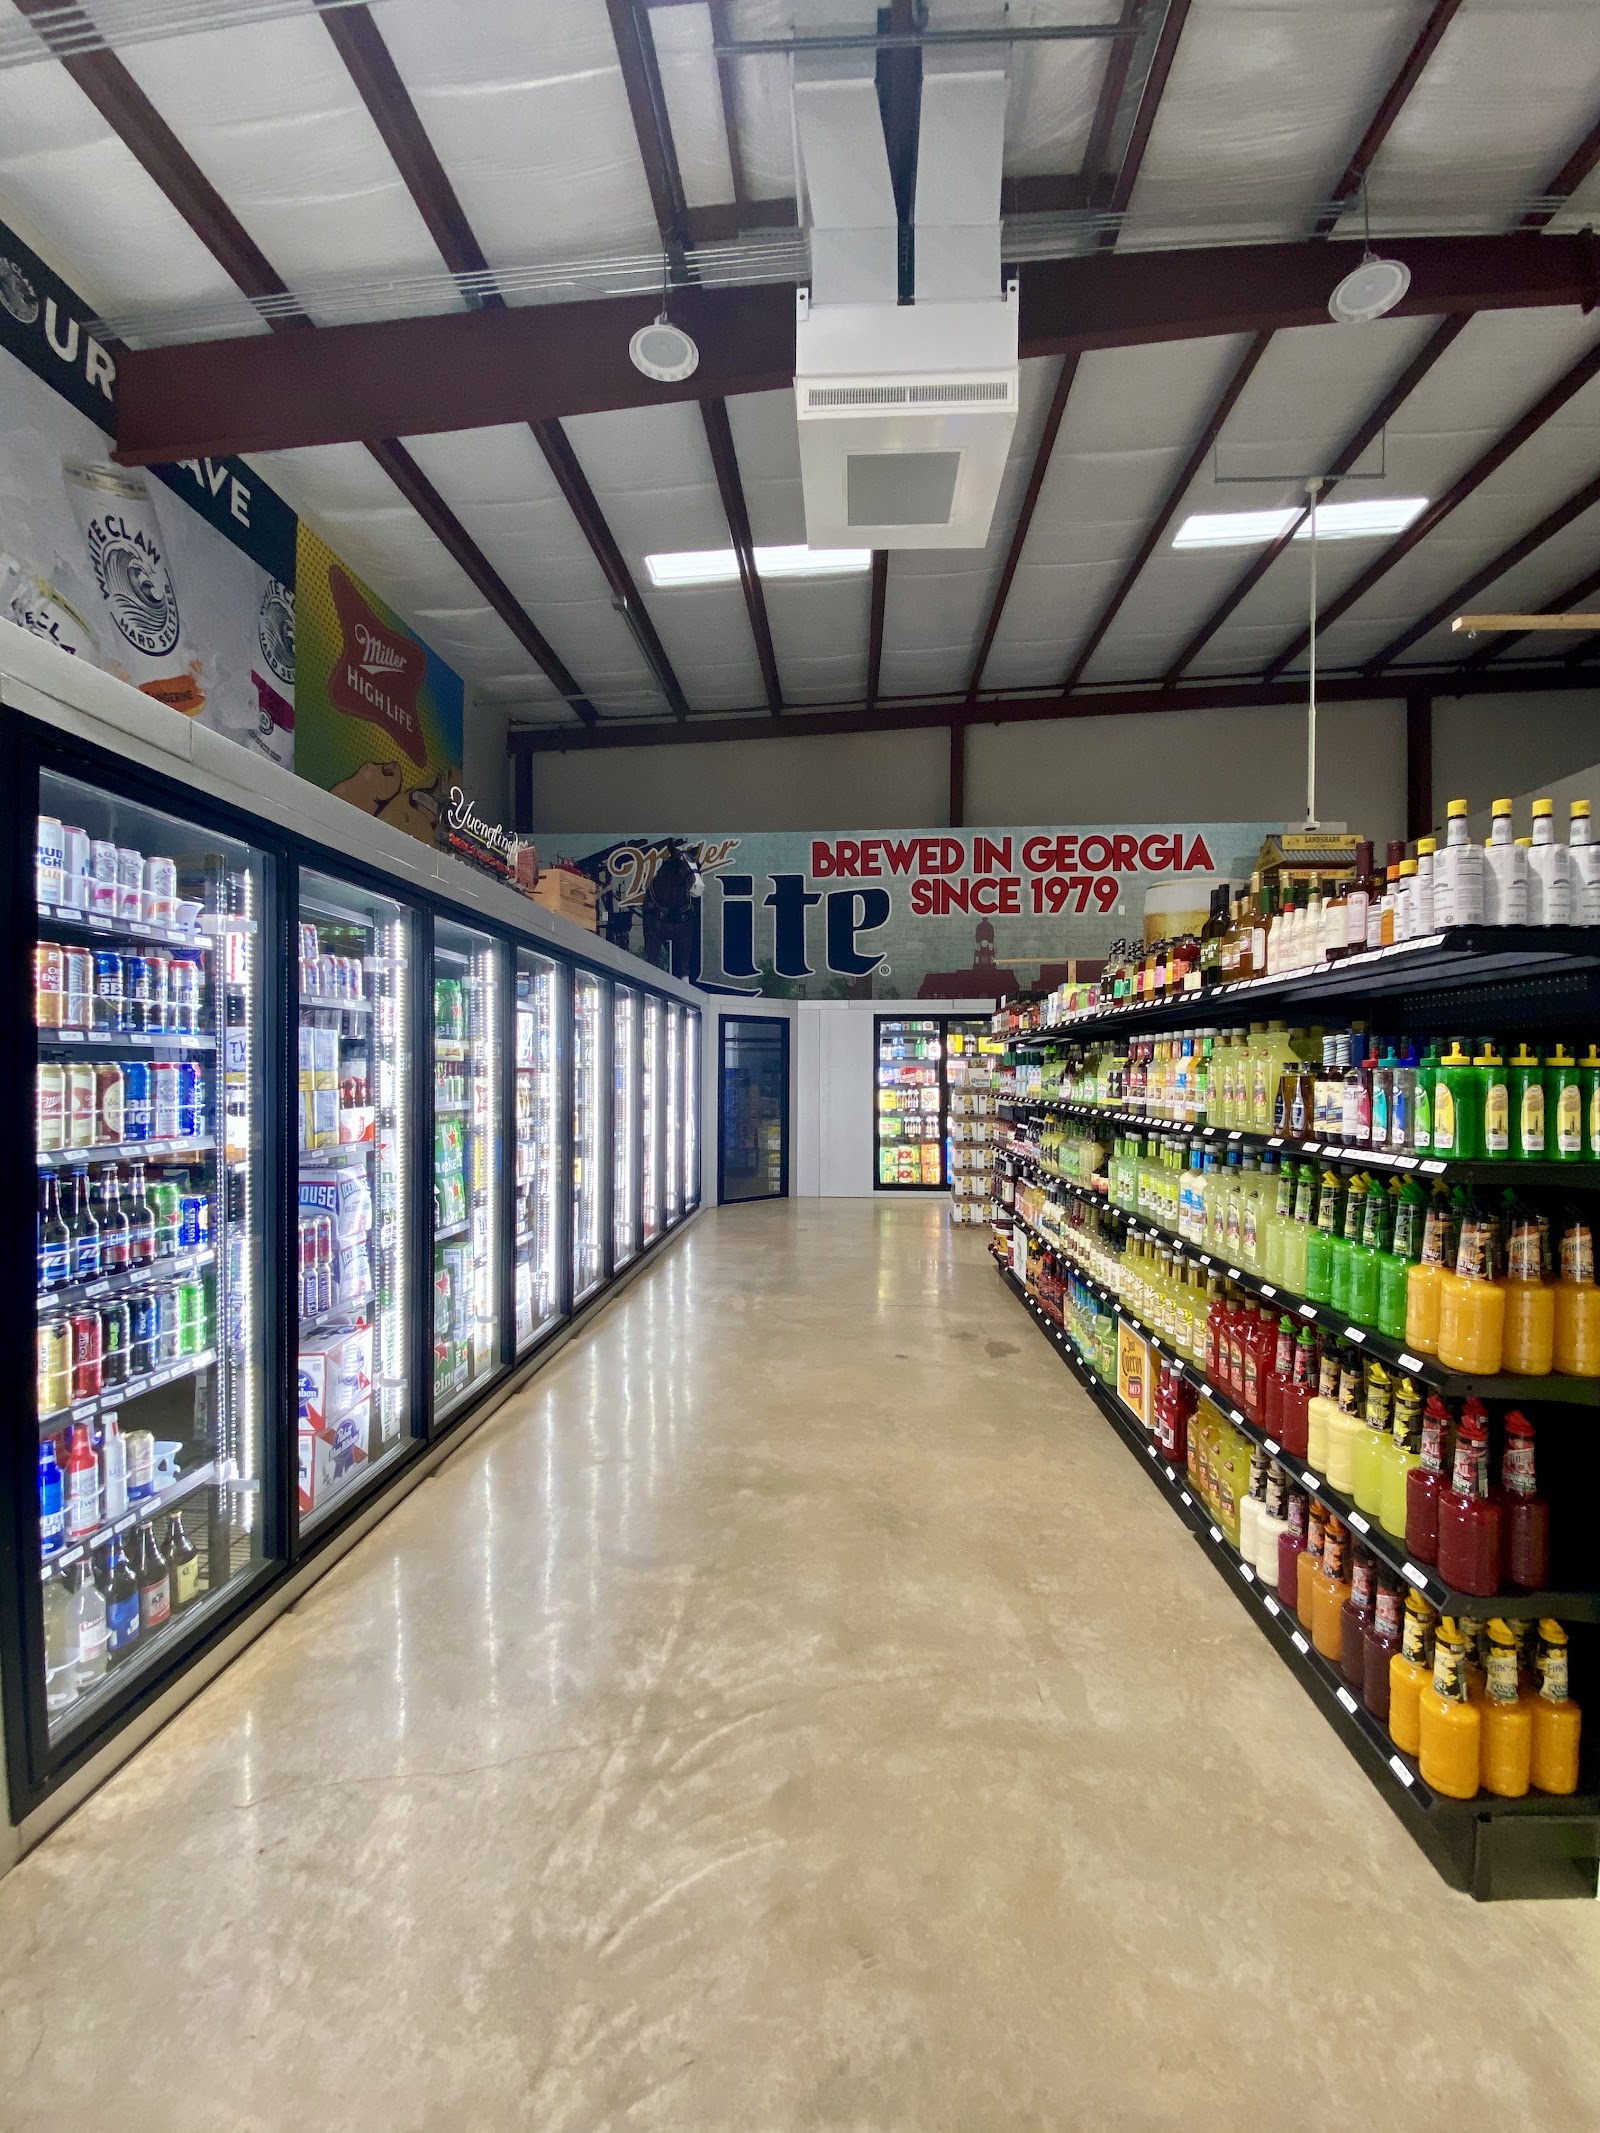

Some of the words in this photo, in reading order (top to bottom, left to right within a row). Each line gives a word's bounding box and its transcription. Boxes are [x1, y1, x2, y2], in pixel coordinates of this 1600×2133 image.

[104, 515, 161, 566] CLAW
[119, 617, 156, 650] HARD
[354, 623, 408, 664] Miller
[347, 664, 384, 711] HIGH
[386, 701, 414, 733] LIFE
[811, 836, 966, 879] BREWED
[972, 836, 1012, 875] IN
[1021, 833, 1216, 873] GEORGIA
[910, 877, 1021, 915] SINCE
[1030, 875, 1120, 914] 1979
